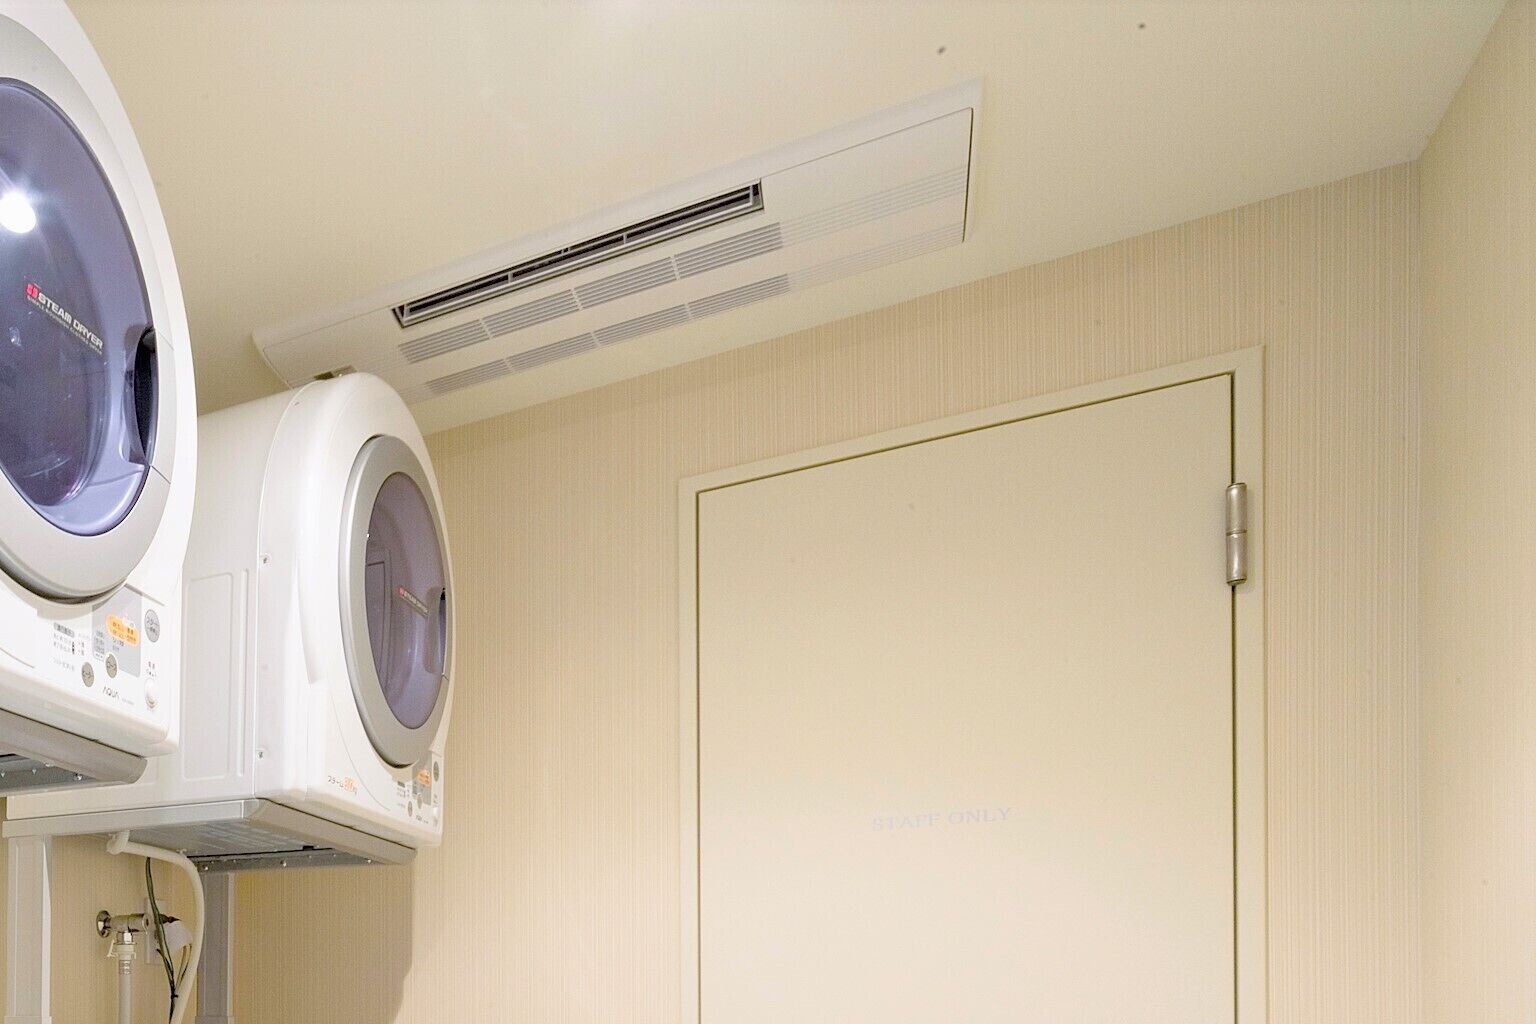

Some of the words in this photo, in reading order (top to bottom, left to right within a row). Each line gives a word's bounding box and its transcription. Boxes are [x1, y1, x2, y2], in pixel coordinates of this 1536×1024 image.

[38, 292, 72, 324] STEAM
[72, 319, 103, 350] DRYER
[948, 806, 1011, 825] ONLY
